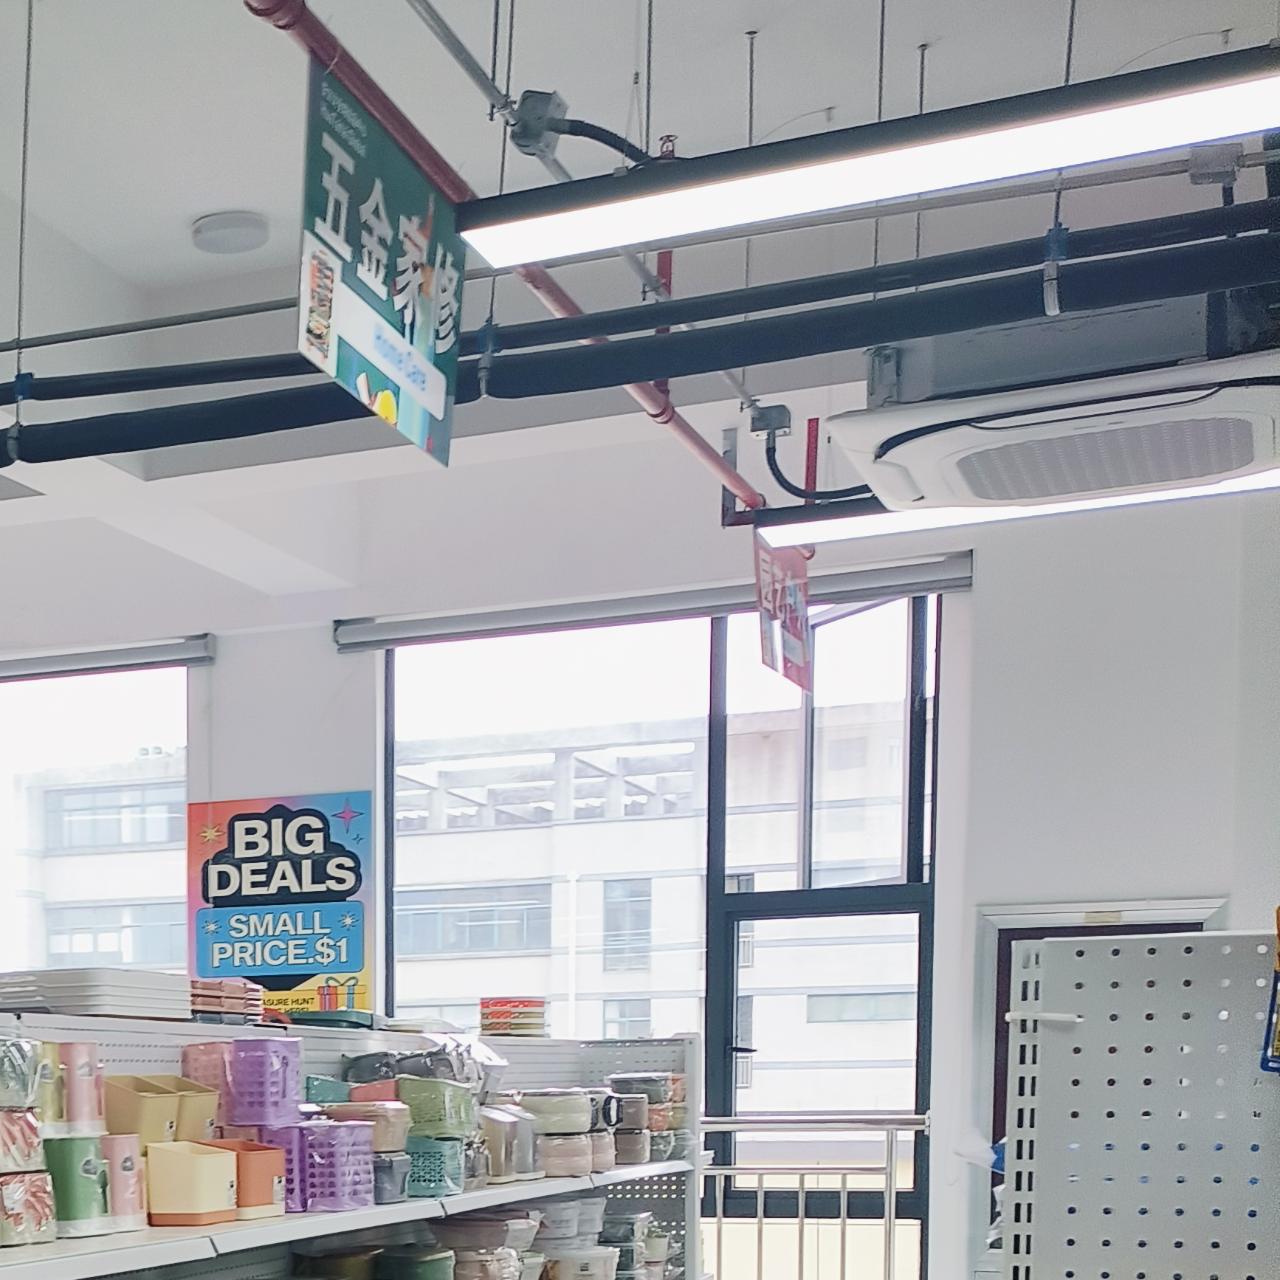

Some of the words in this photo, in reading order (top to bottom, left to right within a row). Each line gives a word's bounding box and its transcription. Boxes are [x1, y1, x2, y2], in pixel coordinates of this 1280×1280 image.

[233, 815, 325, 857] BIG
[207, 856, 357, 898] DEALS
[228, 910, 331, 938] SMALL
[211, 935, 349, 968] PRICE.$1
[291, 997, 314, 1006] HUNT
